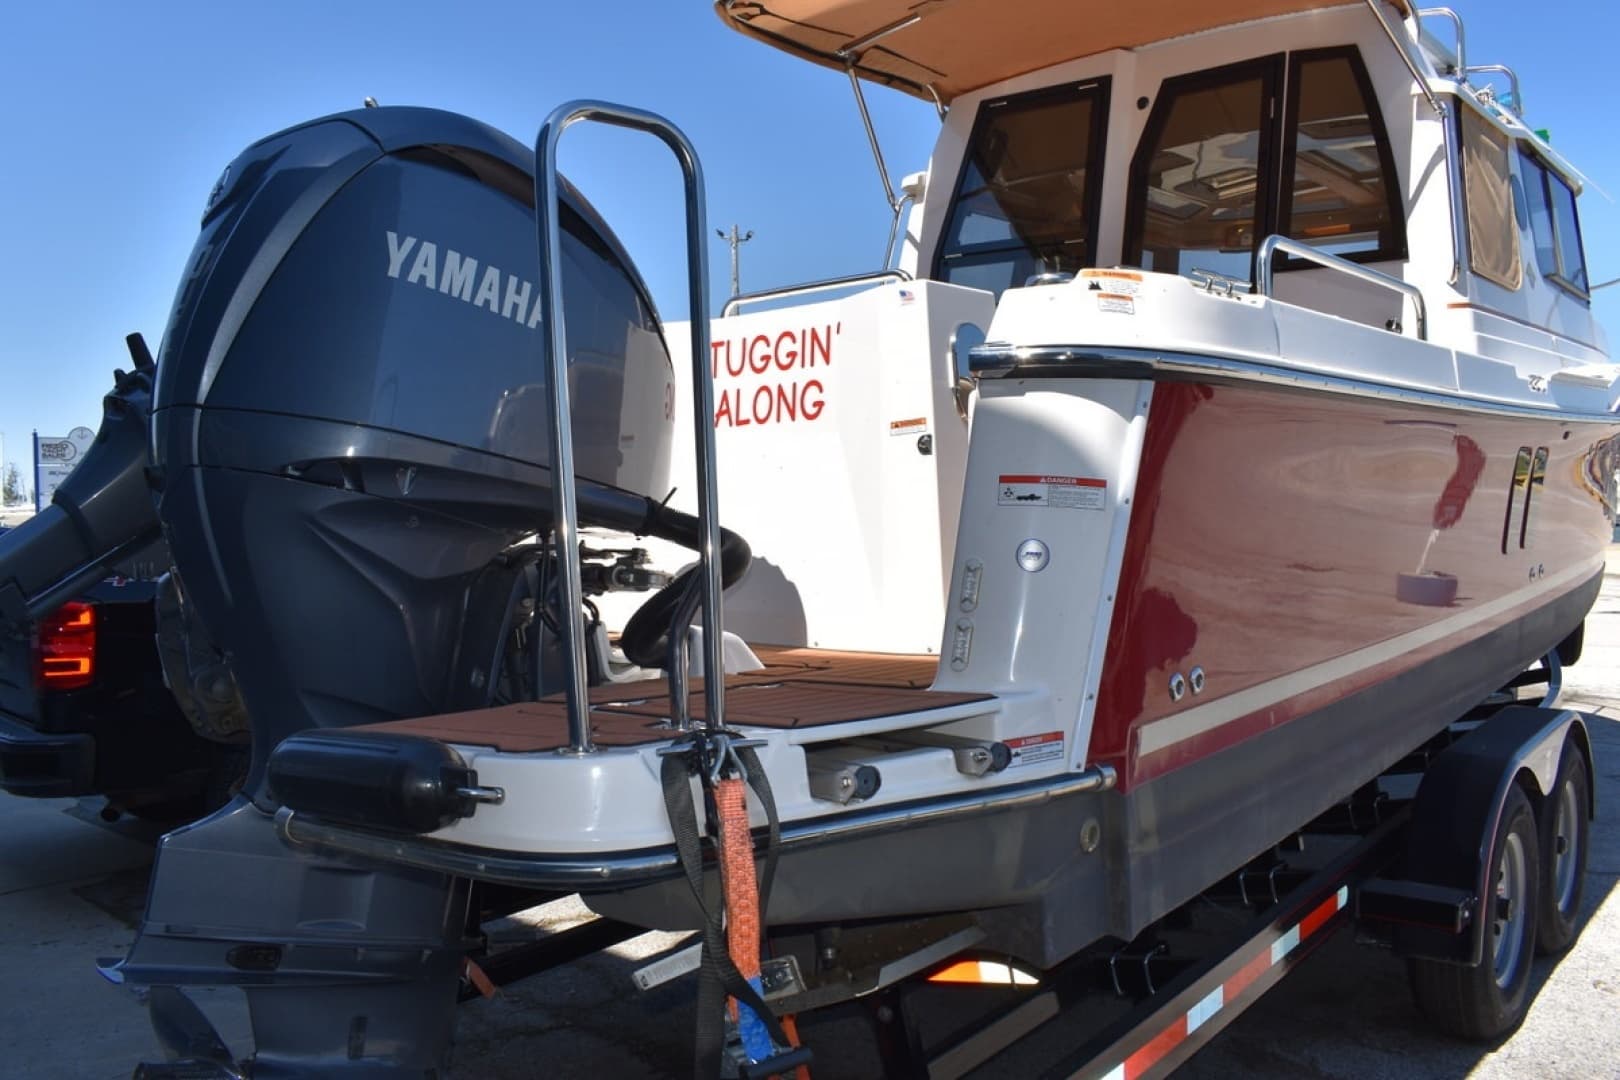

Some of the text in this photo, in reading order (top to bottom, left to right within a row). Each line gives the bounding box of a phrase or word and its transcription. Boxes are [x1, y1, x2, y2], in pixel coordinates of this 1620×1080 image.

[711, 321, 841, 379] TUGGIN'
[714, 379, 825, 428] ALONG
[1047, 477, 1077, 485] DANGER
